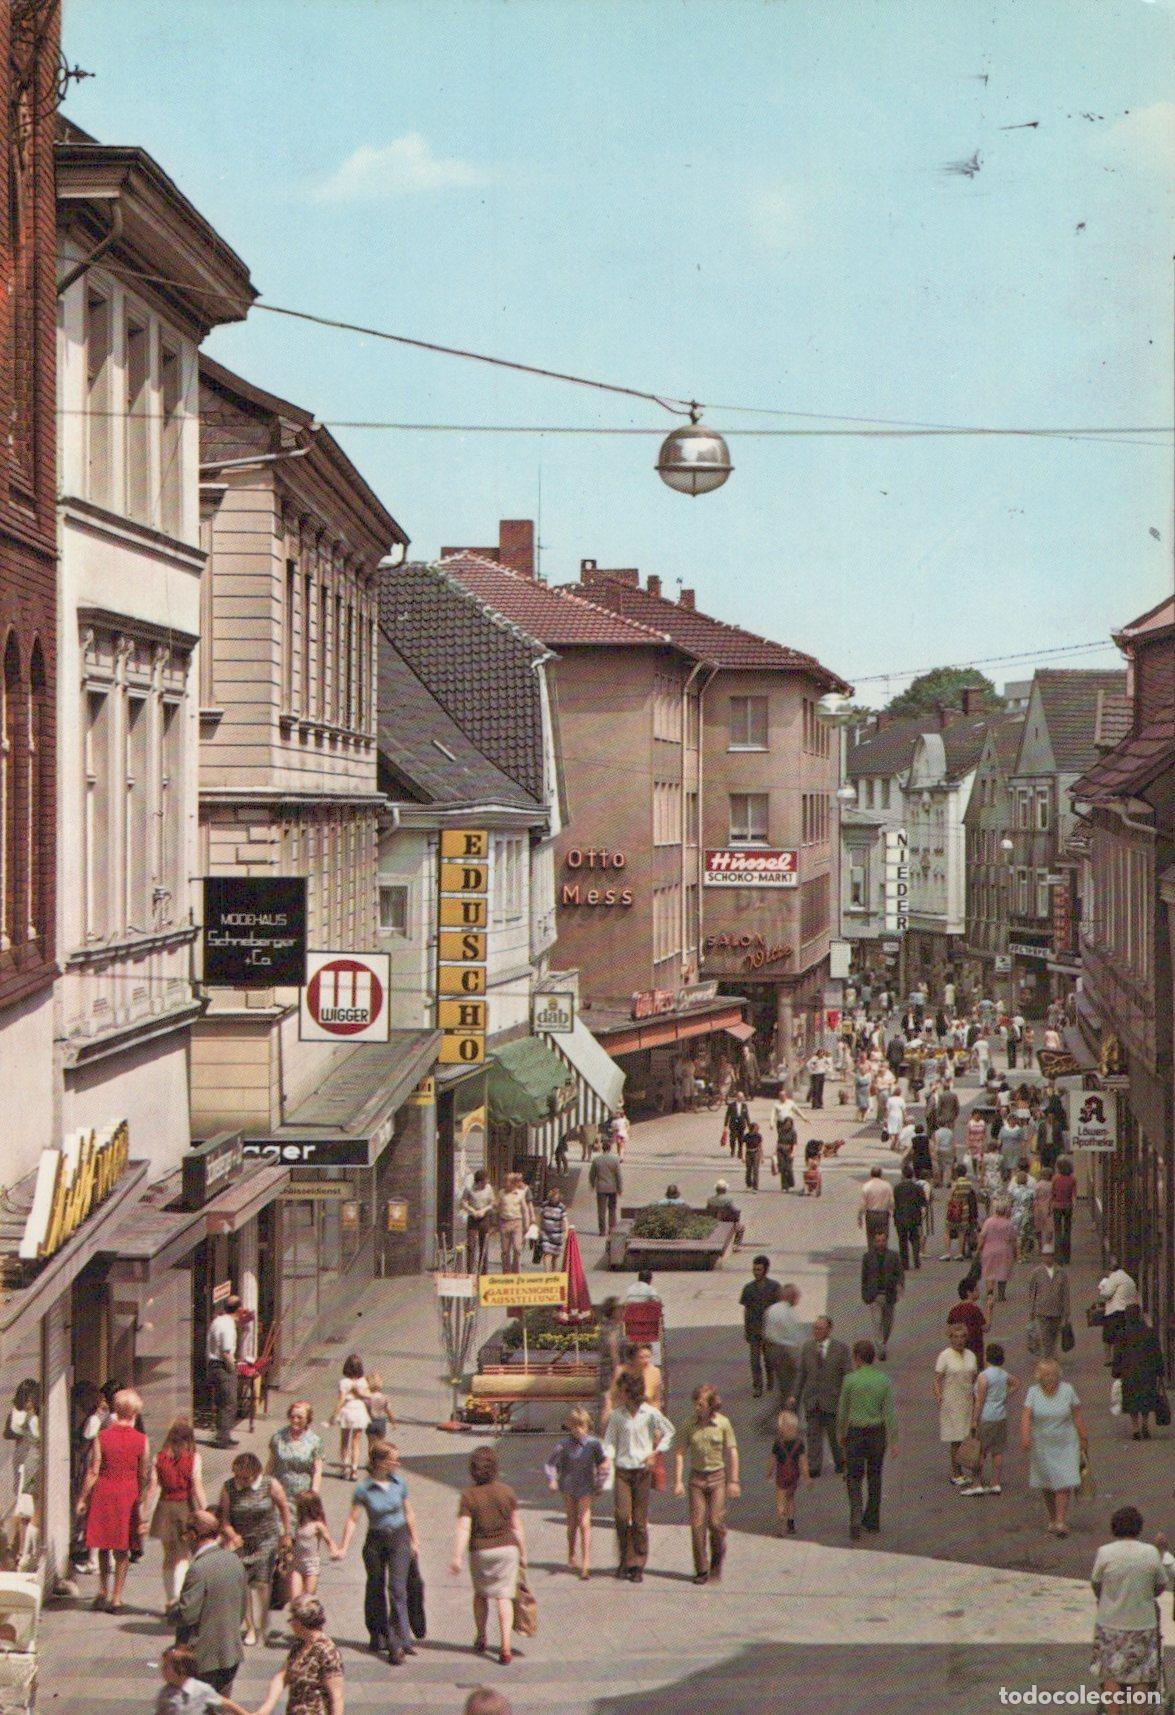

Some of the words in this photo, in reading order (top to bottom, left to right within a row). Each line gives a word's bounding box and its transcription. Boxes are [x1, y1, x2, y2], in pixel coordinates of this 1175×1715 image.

[567, 848, 626, 869] Otto
[710, 851, 791, 871] Hüssel
[708, 872, 793, 883] SCHOKO-MARKT
[896, 832, 907, 931] NIEDER
[562, 885, 632, 905] Mess
[220, 913, 287, 926] MODEHAUS
[458, 834, 483, 1061] EDUSCHO
[321, 1008, 370, 1022] WIGGER
[537, 1009, 569, 1024] dab
[1073, 1137, 1114, 1148] Apotheke
